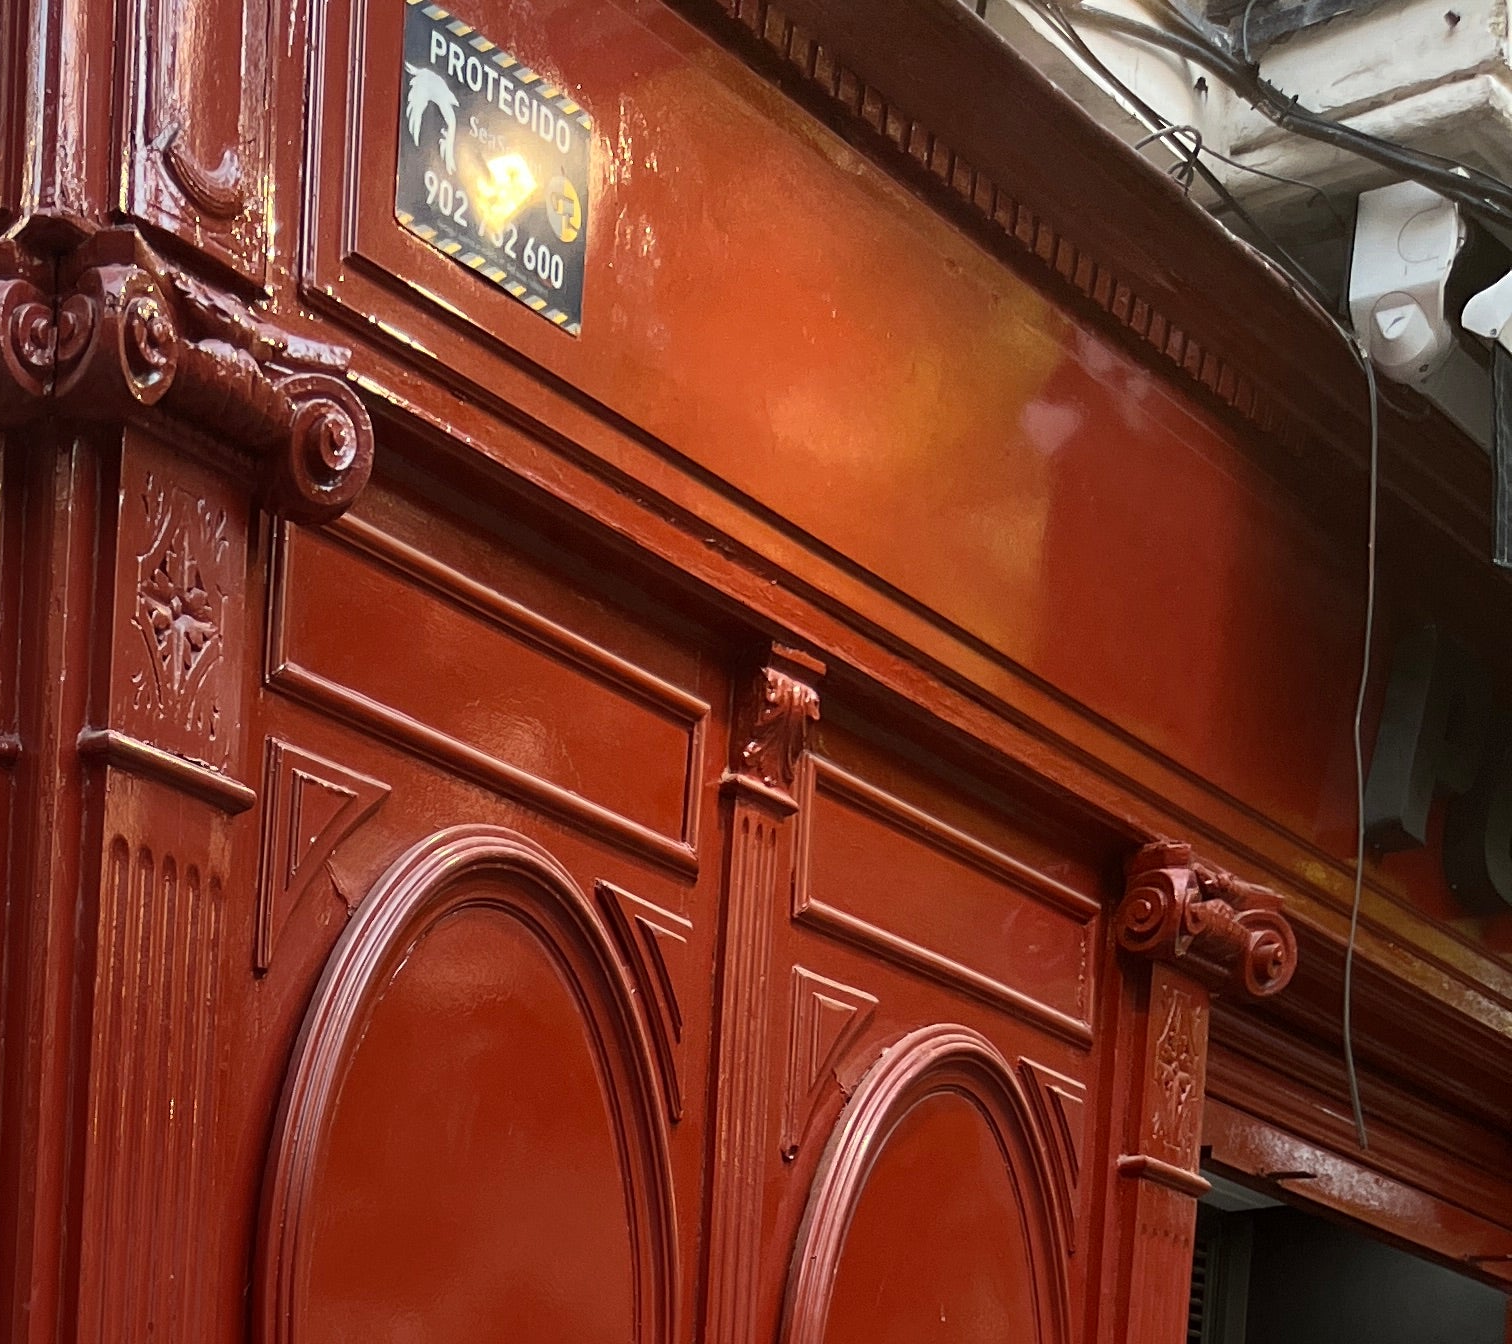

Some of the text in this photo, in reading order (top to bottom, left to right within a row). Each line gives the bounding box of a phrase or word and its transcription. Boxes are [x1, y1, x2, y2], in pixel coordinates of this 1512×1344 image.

[429, 30, 571, 154] PROTEGIDO
[424, 170, 468, 228] 902
[523, 236, 564, 290] 600
